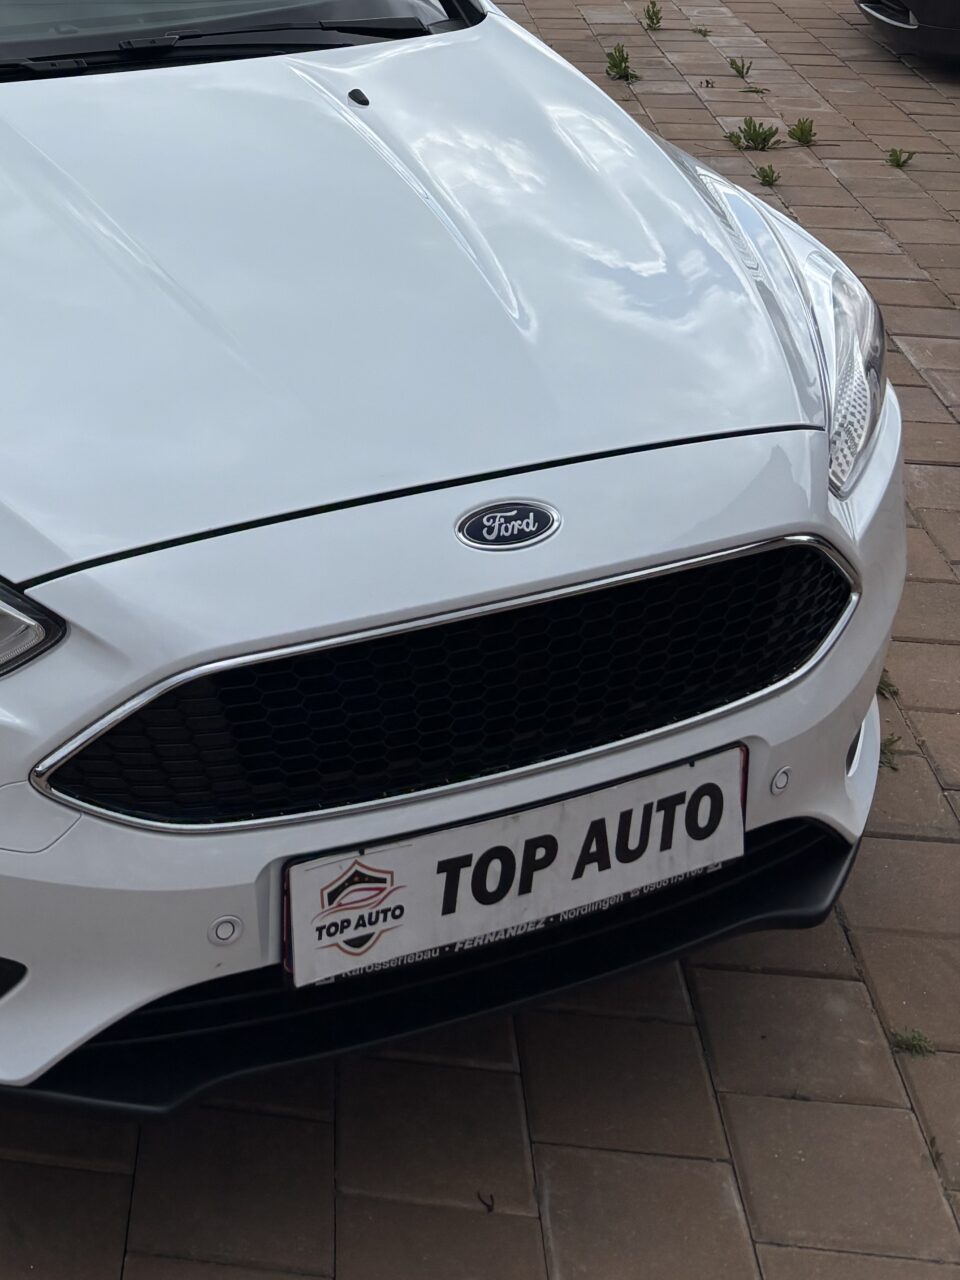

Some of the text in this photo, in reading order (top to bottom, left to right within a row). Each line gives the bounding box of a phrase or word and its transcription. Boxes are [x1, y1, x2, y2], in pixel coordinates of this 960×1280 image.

[482, 509, 538, 540] Ford
[436, 782, 724, 916] TOP AUTO
[315, 904, 405, 941] TOP AUTO
